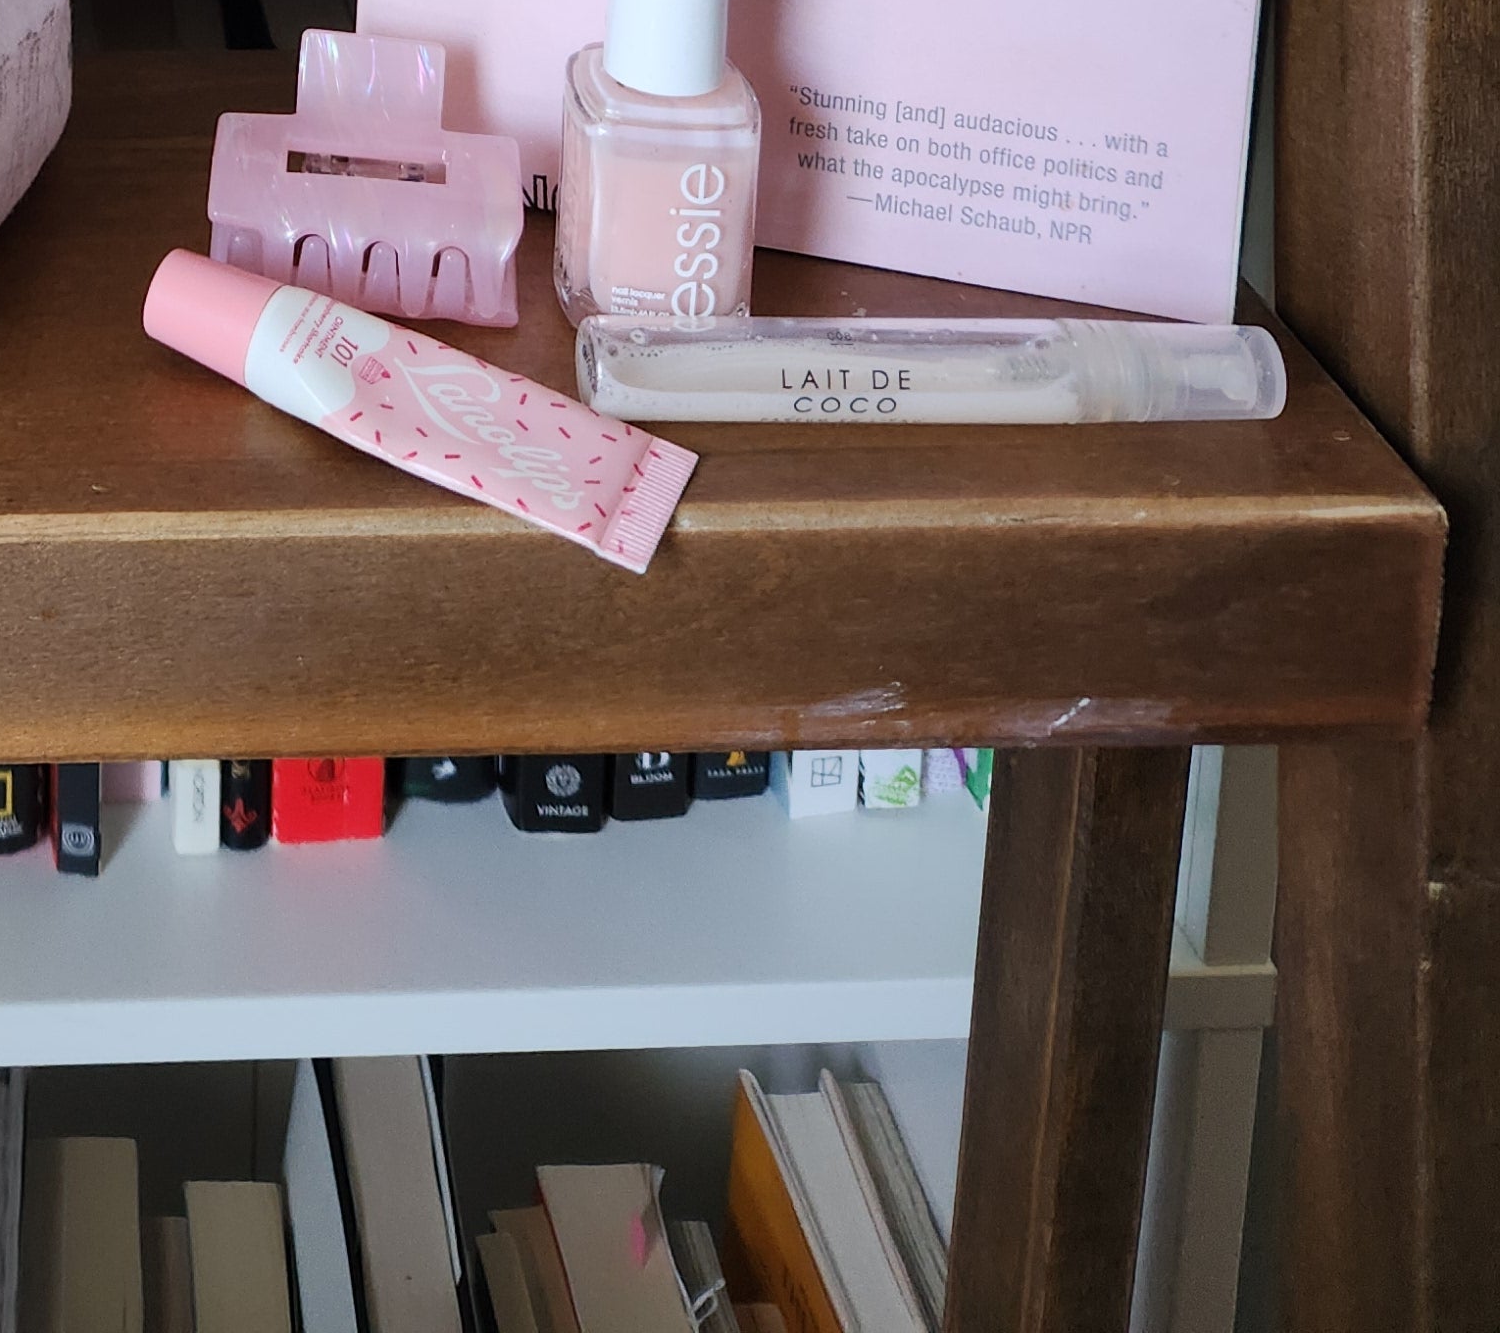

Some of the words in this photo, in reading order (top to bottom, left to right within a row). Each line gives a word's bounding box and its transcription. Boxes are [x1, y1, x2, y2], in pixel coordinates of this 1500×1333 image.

[789, 116, 839, 143] fresh
[846, 124, 889, 150] take
[896, 134, 921, 153] on
[927, 136, 973, 162] both
[978, 142, 1036, 172] office
[1043, 153, 1118, 187] politics
[1125, 166, 1165, 191] and
[894, 100, 946, 128] [and]
[953, 110, 1059, 143] audacious
[1104, 133, 1152, 158] with
[1156, 141, 1169, 158] a
[797, 149, 847, 176] what
[853, 155, 885, 180] the
[890, 162, 1006, 201] apocalypse
[1013, 180, 1072, 213] might
[669, 163, 726, 332] essie
[960, 203, 1043, 240] Schaub,
[1049, 218, 1093, 245] NPR
[330, 336, 359, 367] 101
[781, 368, 851, 390] LAIT
[871, 369, 912, 391] DE
[793, 396, 898, 414] COCO
[396, 355, 585, 512] Lanolips
[536, 803, 589, 817] VINTAGE
